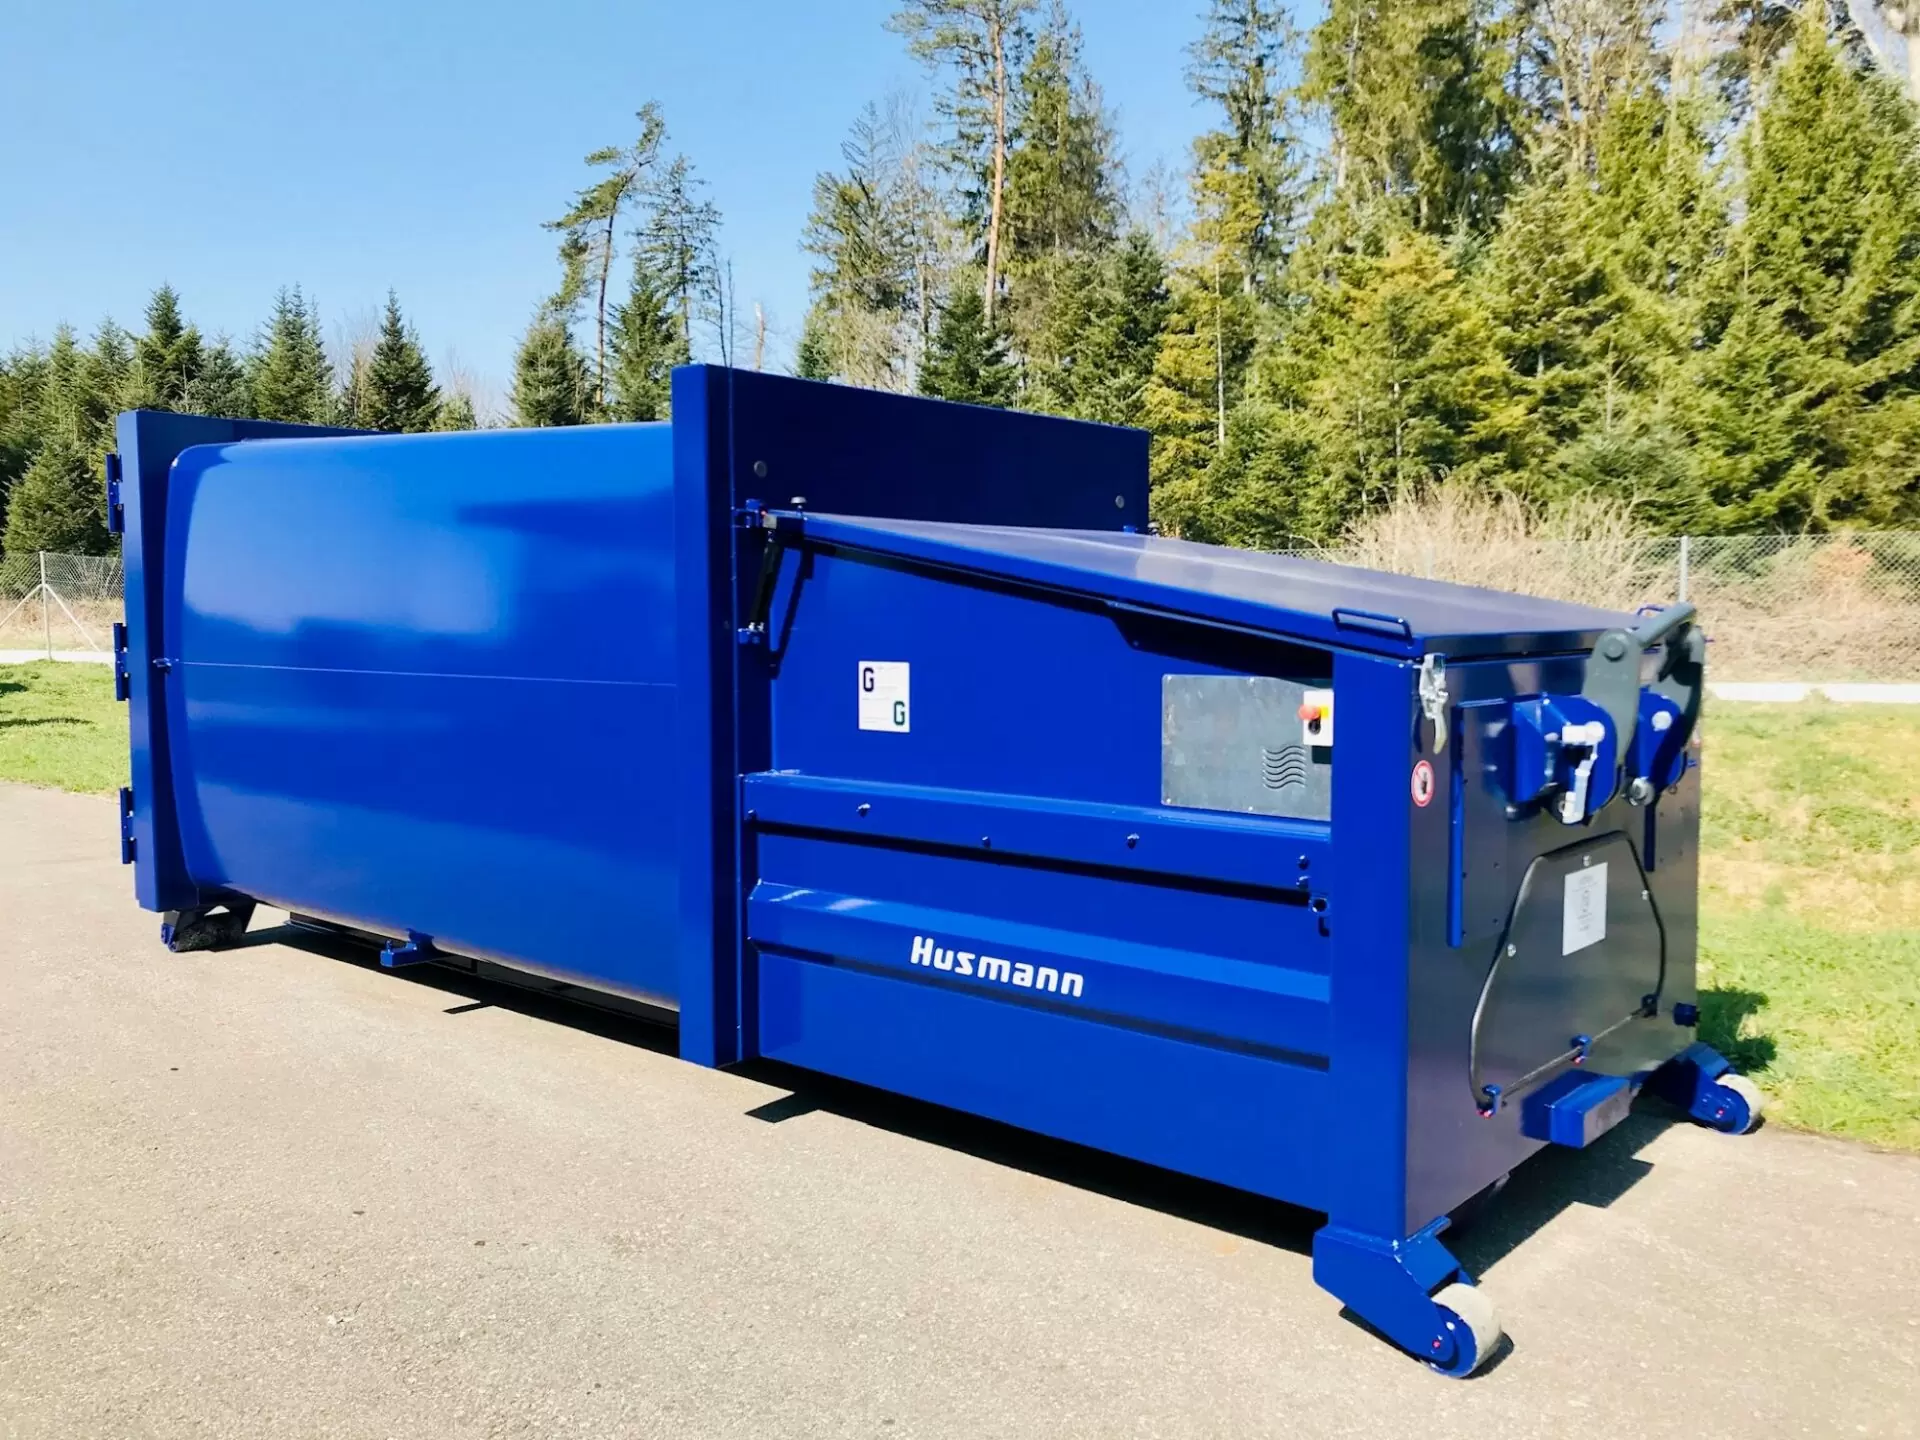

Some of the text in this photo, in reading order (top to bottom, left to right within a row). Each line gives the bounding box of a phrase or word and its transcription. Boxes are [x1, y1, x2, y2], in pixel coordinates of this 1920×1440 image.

[863, 667, 874, 692] G
[894, 700, 905, 726] G
[910, 935, 1084, 998] Husmann
